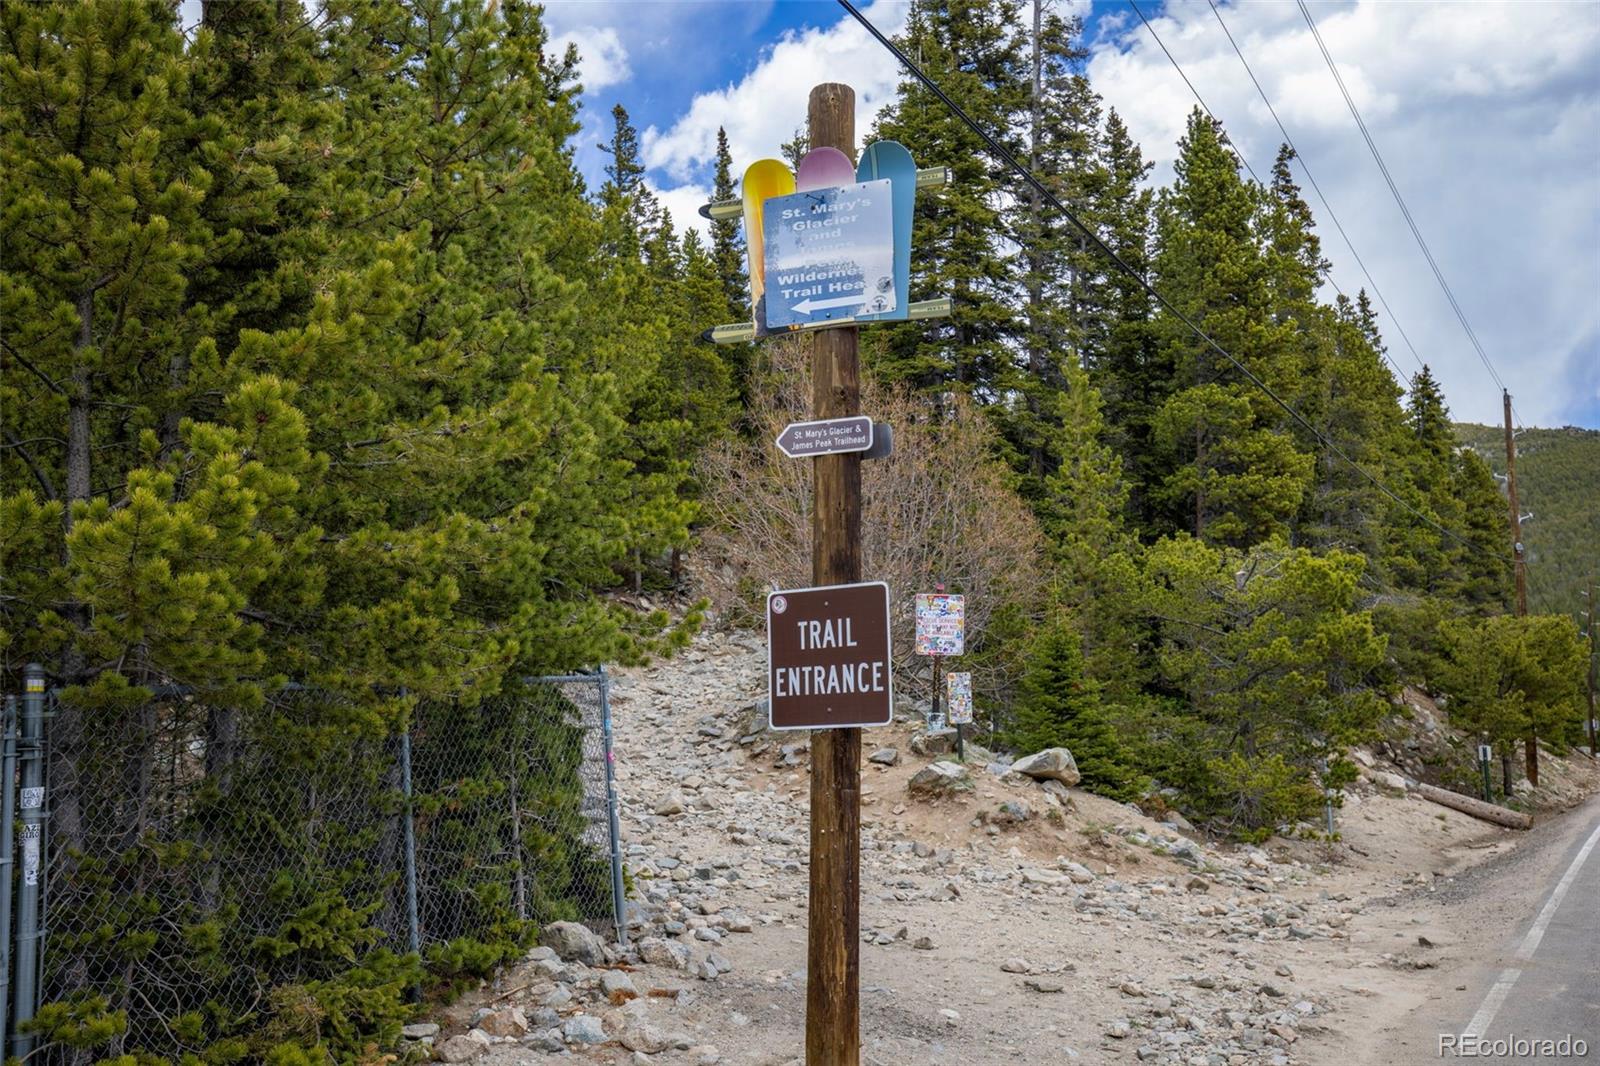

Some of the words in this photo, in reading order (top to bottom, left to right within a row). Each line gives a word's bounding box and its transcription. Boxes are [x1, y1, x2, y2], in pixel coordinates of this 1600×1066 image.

[782, 208, 805, 220] St.
[792, 214, 859, 231] Glacier
[781, 285, 822, 299] Trail
[828, 280, 867, 293] Hea
[805, 428, 827, 438] Mary's
[829, 426, 853, 436] Glacier
[855, 424, 862, 433] &
[791, 440, 813, 451] James
[815, 438, 832, 448] Peak
[834, 435, 866, 446] Trailhead
[797, 617, 858, 650] TRAIL
[776, 661, 884, 697] ENTRANCE
